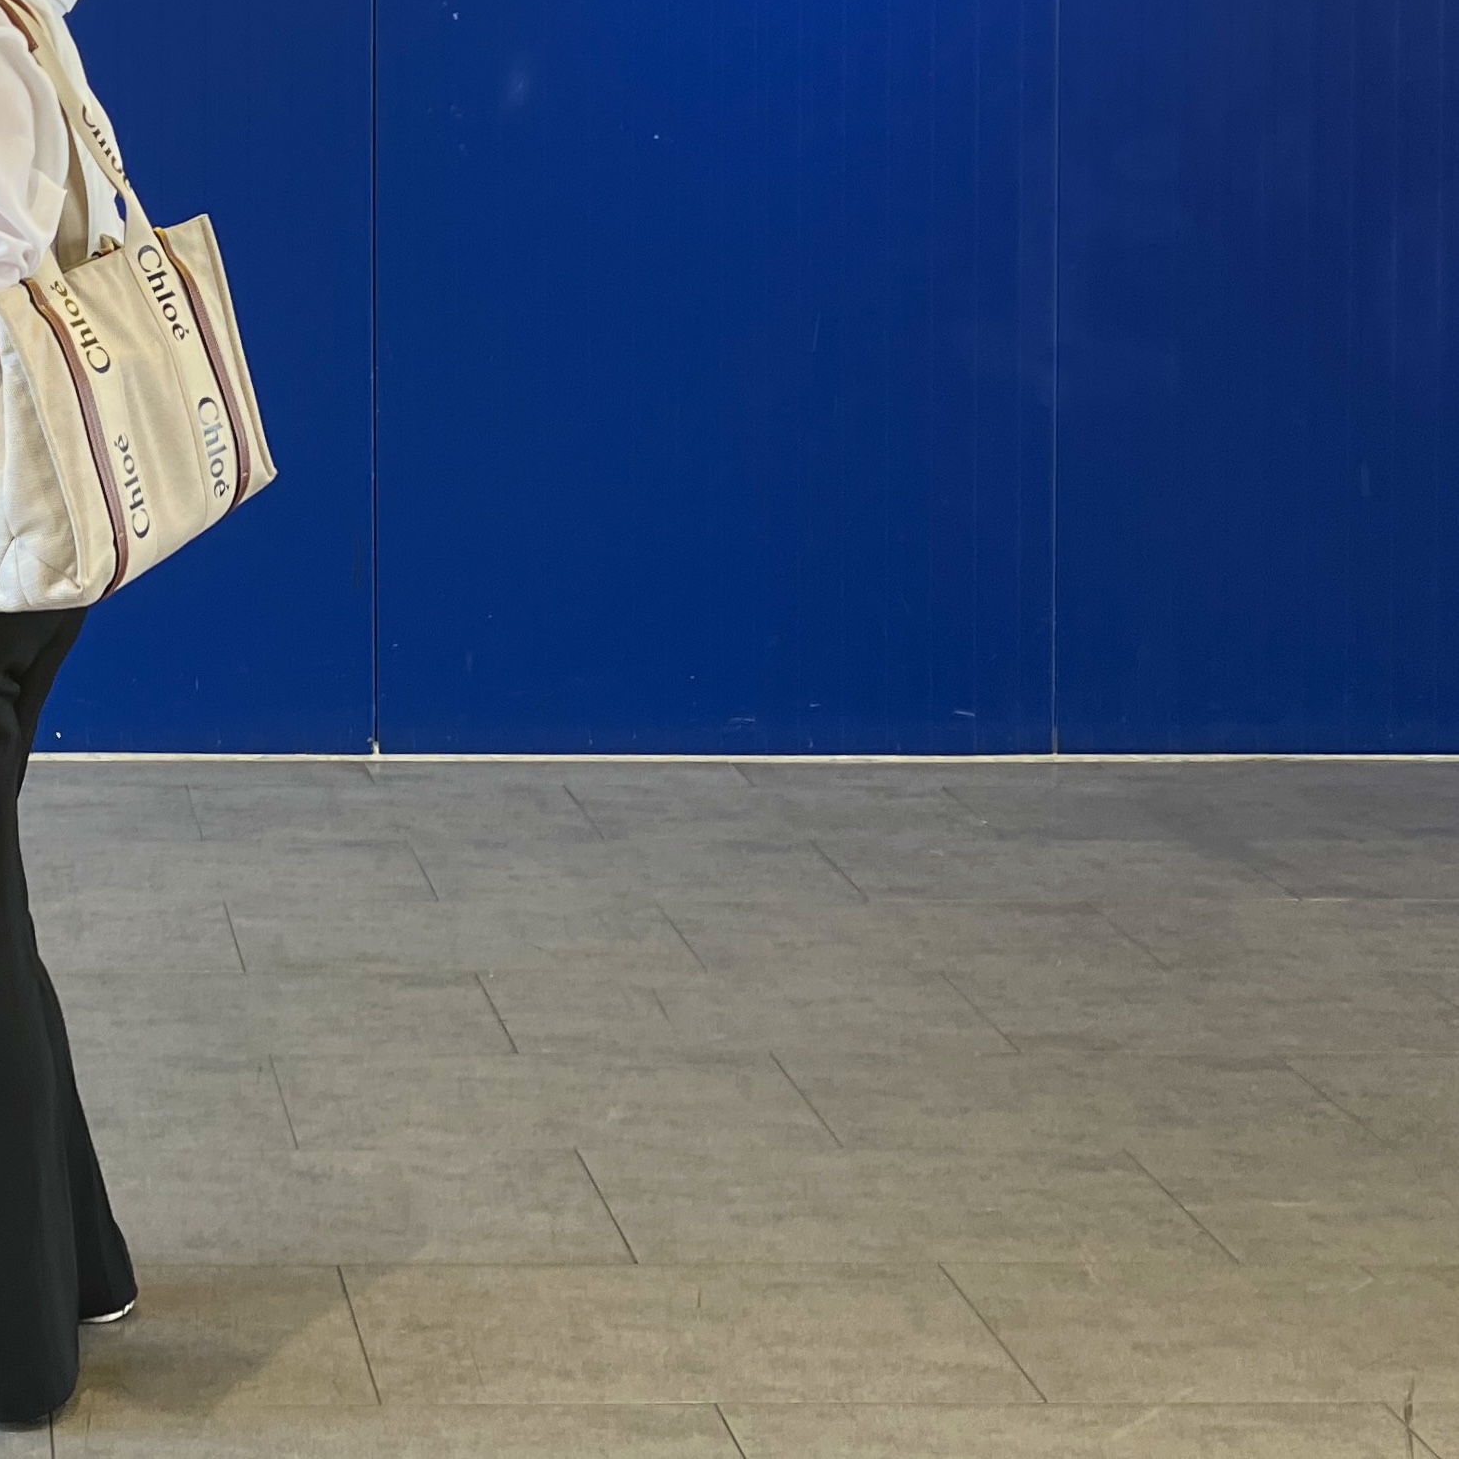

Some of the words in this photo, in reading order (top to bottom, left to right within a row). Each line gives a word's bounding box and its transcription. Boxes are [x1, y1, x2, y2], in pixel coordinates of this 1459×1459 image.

[50, 280, 111, 374] Chloé
[138, 244, 190, 341] Chloé
[113, 431, 150, 539] Chloé
[197, 396, 230, 499] Chloé
